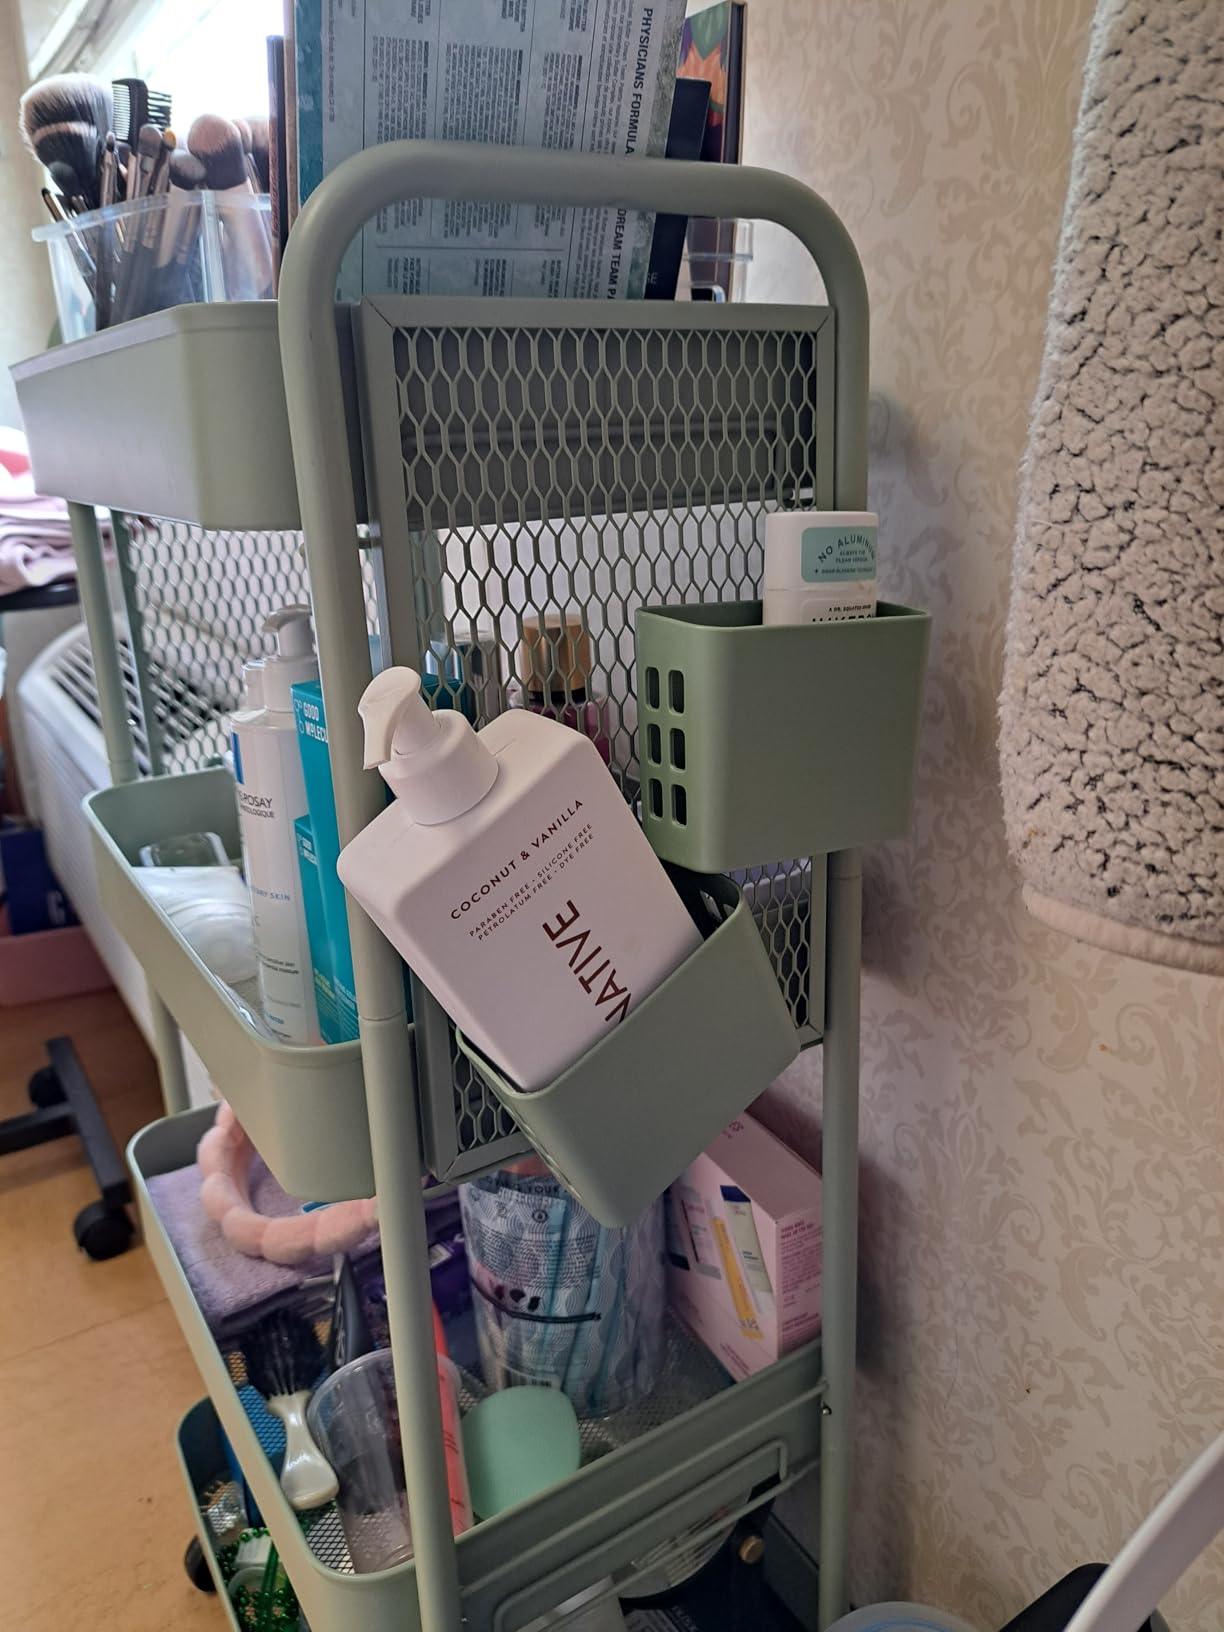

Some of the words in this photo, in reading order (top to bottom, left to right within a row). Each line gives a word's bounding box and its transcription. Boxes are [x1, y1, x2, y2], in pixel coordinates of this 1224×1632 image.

[633, 7, 654, 89] PHYSICIANS
[625, 93, 643, 154] FORMULA
[612, 208, 627, 250] DREAM
[607, 254, 622, 285] TEAM
[818, 546, 833, 563] NO
[303, 701, 320, 721] GOOD
[450, 860, 517, 920] COCONUT
[520, 850, 530, 861] &
[531, 800, 584, 849] VANILLA
[469, 902, 509, 937] PARABEN
[509, 882, 531, 904] FREE
[537, 842, 573, 879] SILICONE
[574, 823, 593, 843] FREE
[478, 893, 532, 941] PETROLATUM
[532, 874, 553, 894] FREE
[559, 852, 575, 869] DYE
[575, 833, 594, 853] FREE
